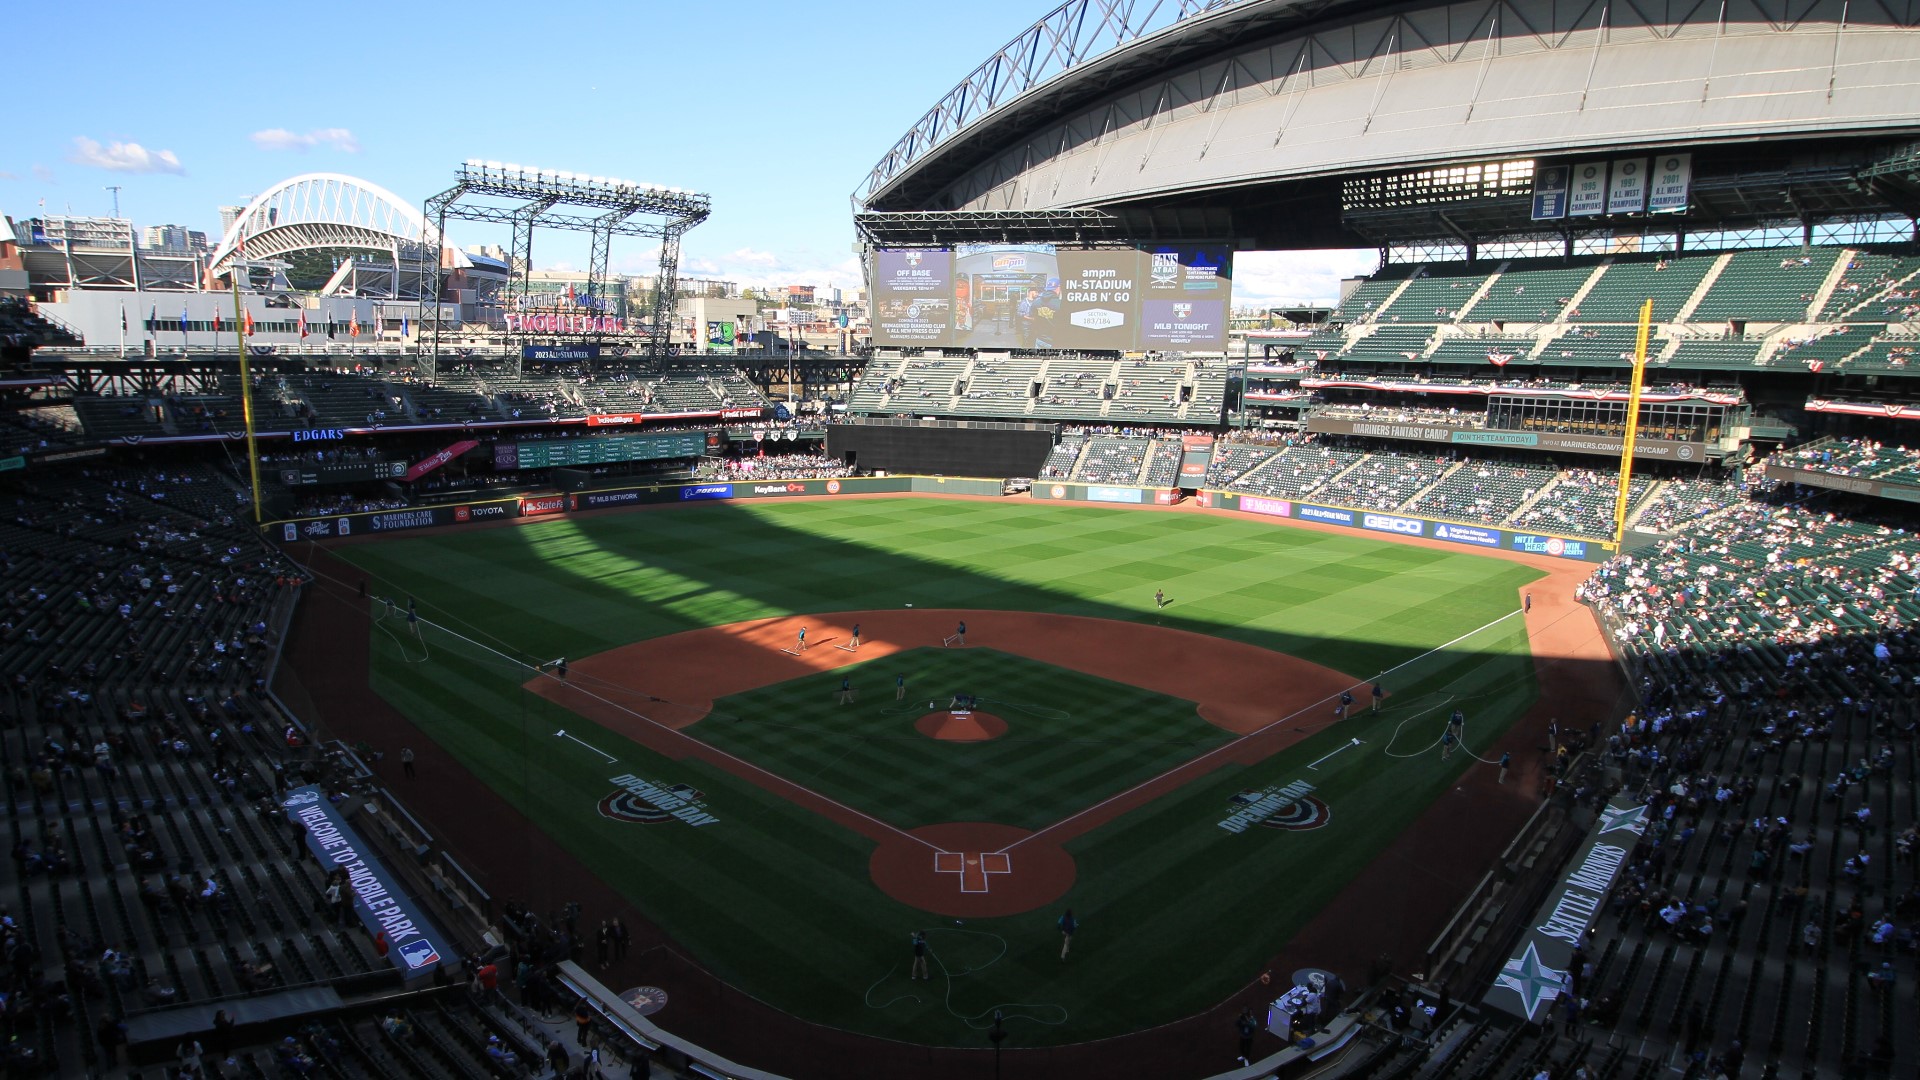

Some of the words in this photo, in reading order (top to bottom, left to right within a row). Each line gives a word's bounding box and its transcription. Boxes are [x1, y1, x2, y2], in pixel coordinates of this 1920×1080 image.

[1620, 178, 1636, 188] 1997
[1662, 175, 1680, 184] 2001
[1624, 189, 1639, 198] WEST
[1667, 185, 1683, 193] WEST
[1585, 192, 1599, 200] WEST
[1651, 195, 1685, 205] CHAMPIONS
[1571, 201, 1602, 212] CHAMPIONS
[1609, 199, 1642, 209] CHAMPIONS
[993, 258, 1024, 268] ampm
[1152, 254, 1178, 266] FANS
[1082, 269, 1116, 279] ampm
[1066, 279, 1132, 290] IN-STADIUM
[1066, 292, 1098, 302] GRAB
[1114, 292, 1130, 302] GO
[582, 315, 625, 333] PARK
[534, 351, 549, 359] 2023
[573, 350, 589, 358] WEEK
[293, 429, 344, 441] EDGARS
[1352, 423, 1390, 436] MARINERS
[1391, 426, 1423, 439] FANTASY
[1424, 428, 1449, 440] CAMP
[1457, 432, 1471, 441] JOIN
[1472, 433, 1485, 442] THE
[1486, 434, 1505, 443] TEAM
[1506, 435, 1532, 444] TODAY!
[1560, 440, 1669, 455] MARINERS.COM/FAASYCAMP
[695, 486, 728, 495] BOEING
[754, 484, 787, 494] KeyBank
[1851, 480, 1872, 493] CAMP
[596, 495, 609, 503] MLB
[609, 493, 638, 502] NETWORK
[383, 512, 416, 522] MARINERS
[416, 511, 432, 519] CARE
[472, 506, 504, 516] TOYOTA
[1301, 507, 1314, 516] 2023
[1335, 511, 1351, 522] WEEK
[383, 516, 433, 529] FOUNDATION
[1364, 515, 1422, 534] GEICO
[1450, 526, 1474, 536] Virginia
[1474, 529, 1488, 538] Mason
[1450, 532, 1477, 542] Franciscan
[1477, 536, 1497, 545] Health
[1514, 535, 1526, 544] HIT
[1526, 536, 1535, 544] IT
[1526, 543, 1545, 551] HERE
[1565, 542, 1580, 551] WIN
[608, 773, 688, 811] OPENING
[670, 805, 720, 827] DAY
[1216, 793, 1294, 834] OPENING
[1278, 779, 1318, 800] DAY
[1565, 841, 1627, 894] MARINERS
[297, 804, 348, 851] WELCOME
[329, 846, 358, 863] TO
[344, 859, 396, 911] T-MOBILE
[374, 905, 421, 943] PARK
[1536, 889, 1600, 945] SEATTLE
